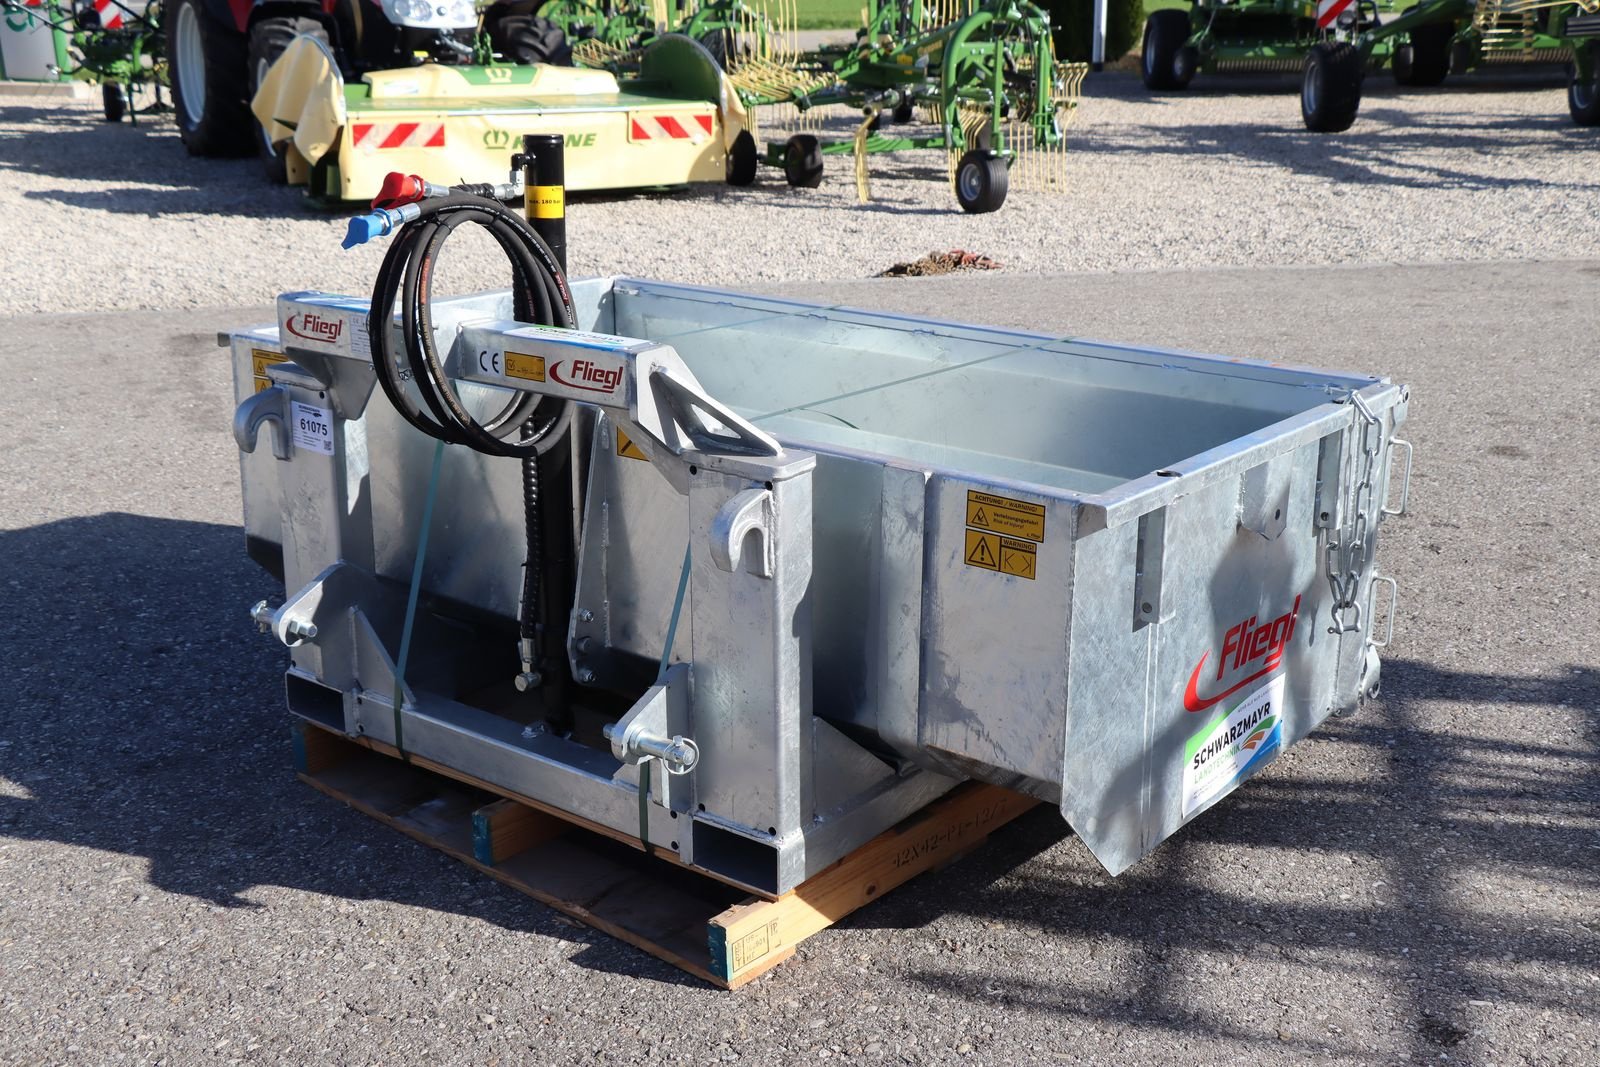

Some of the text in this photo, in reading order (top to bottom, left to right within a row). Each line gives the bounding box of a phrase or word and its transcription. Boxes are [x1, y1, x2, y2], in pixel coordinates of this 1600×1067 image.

[512, 133, 597, 149] KNE
[303, 314, 343, 340] Fliegl
[479, 350, 499, 374] CE
[571, 359, 624, 389] Fliegl
[300, 418, 328, 436] 61075
[1008, 502, 1038, 513] WARNING!
[1003, 538, 1035, 550] WARNING!
[1216, 593, 1302, 681] Fliegl
[1192, 700, 1272, 771] SCHWARZMAYR
[1193, 742, 1242, 785] LANDTECHNIK
